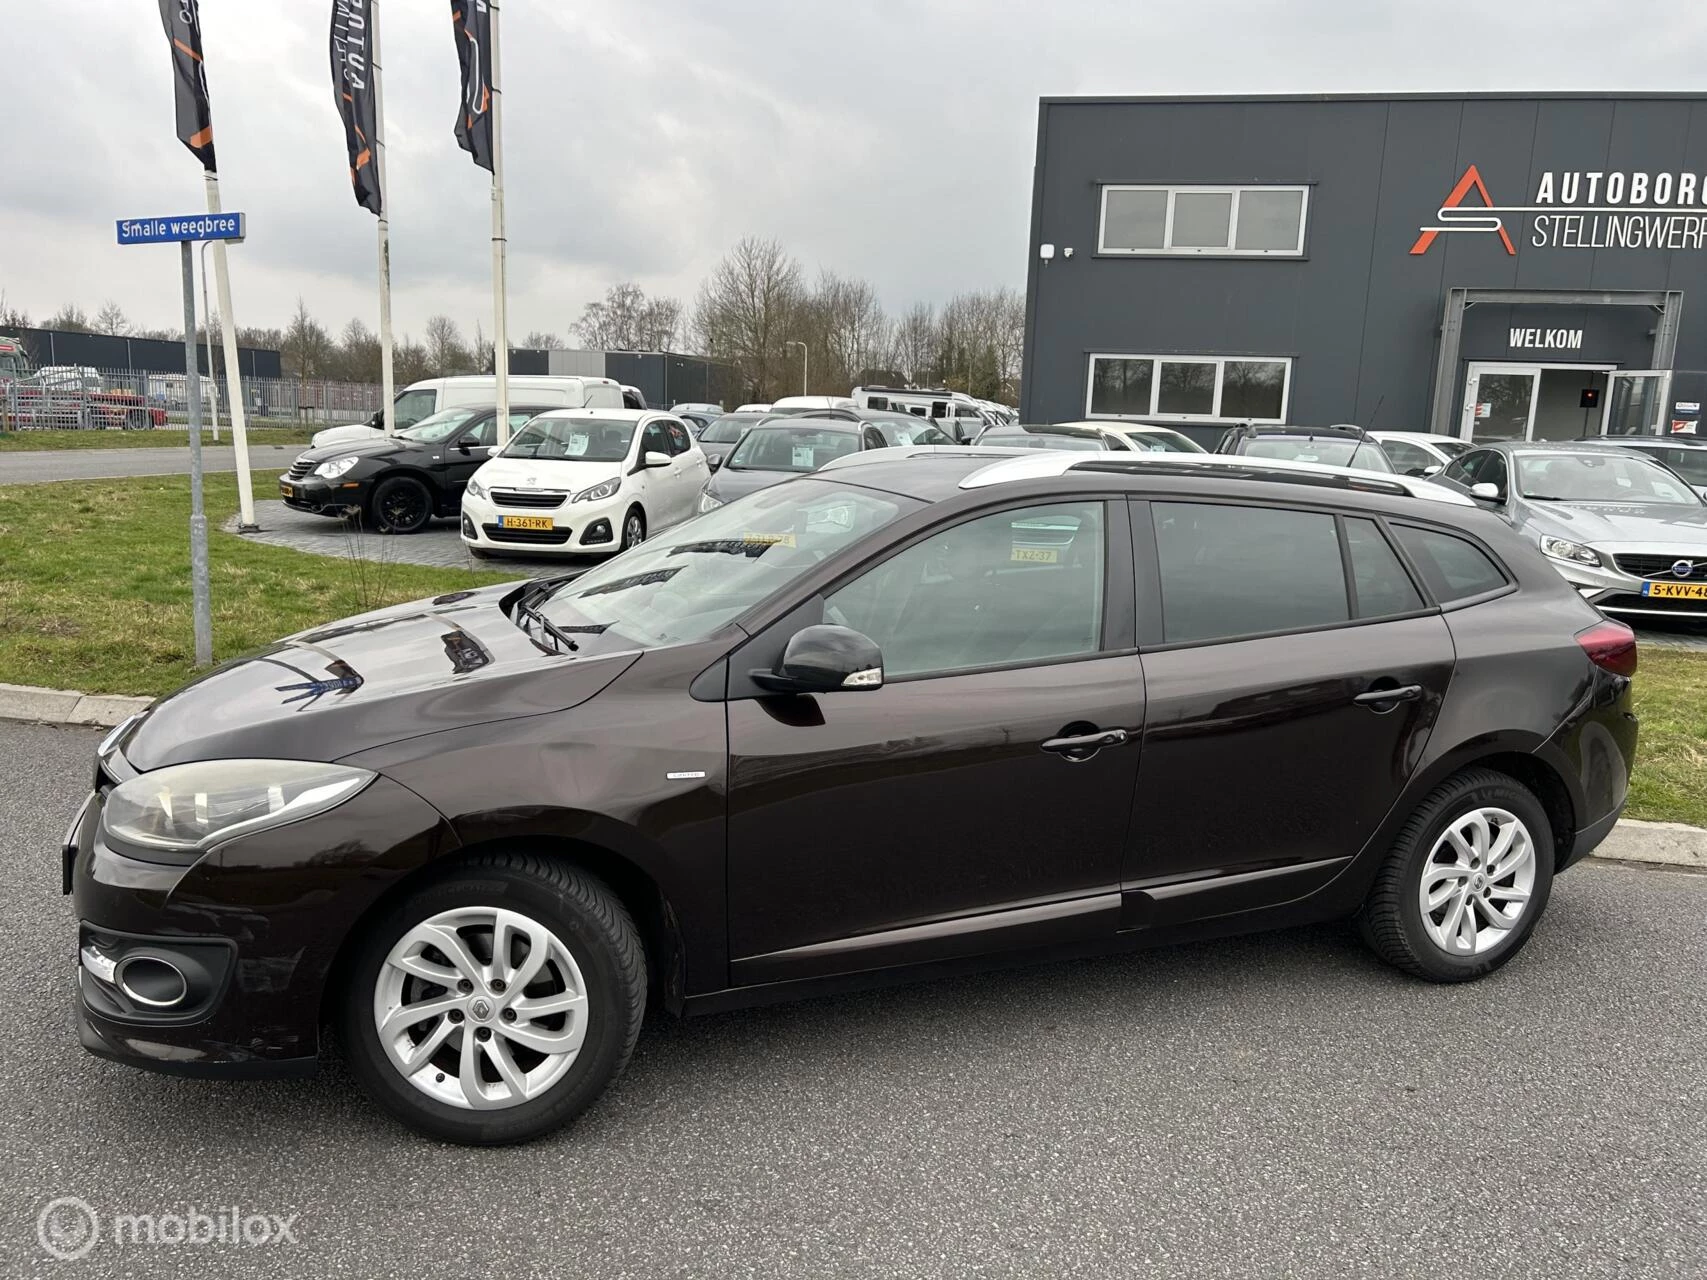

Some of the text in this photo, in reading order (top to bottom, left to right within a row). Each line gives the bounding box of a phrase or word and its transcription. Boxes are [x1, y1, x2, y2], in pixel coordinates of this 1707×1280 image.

[121, 216, 236, 238] Smalle weegbree
[1509, 327, 1583, 349] WELKOM
[506, 517, 548, 529] H-361-RK
